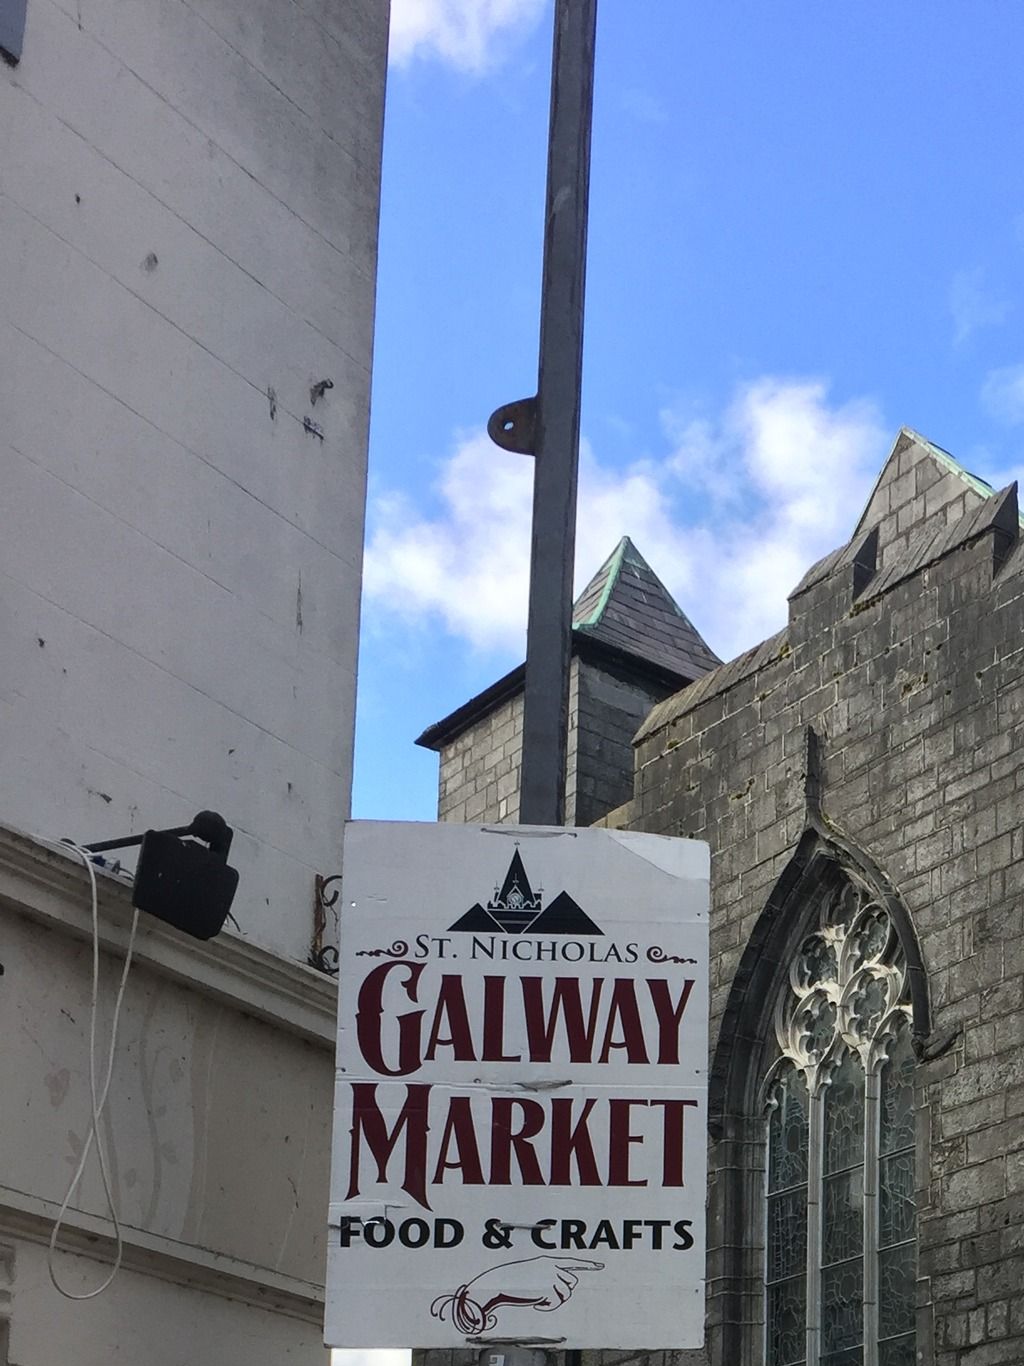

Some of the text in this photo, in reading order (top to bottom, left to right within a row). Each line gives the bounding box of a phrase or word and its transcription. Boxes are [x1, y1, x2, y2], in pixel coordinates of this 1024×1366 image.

[471, 936, 639, 964] NICHOLAS
[355, 960, 696, 1077] GALWAY
[344, 1083, 698, 1211] MARKET
[340, 1216, 694, 1250] FOOD & CRAFTS
